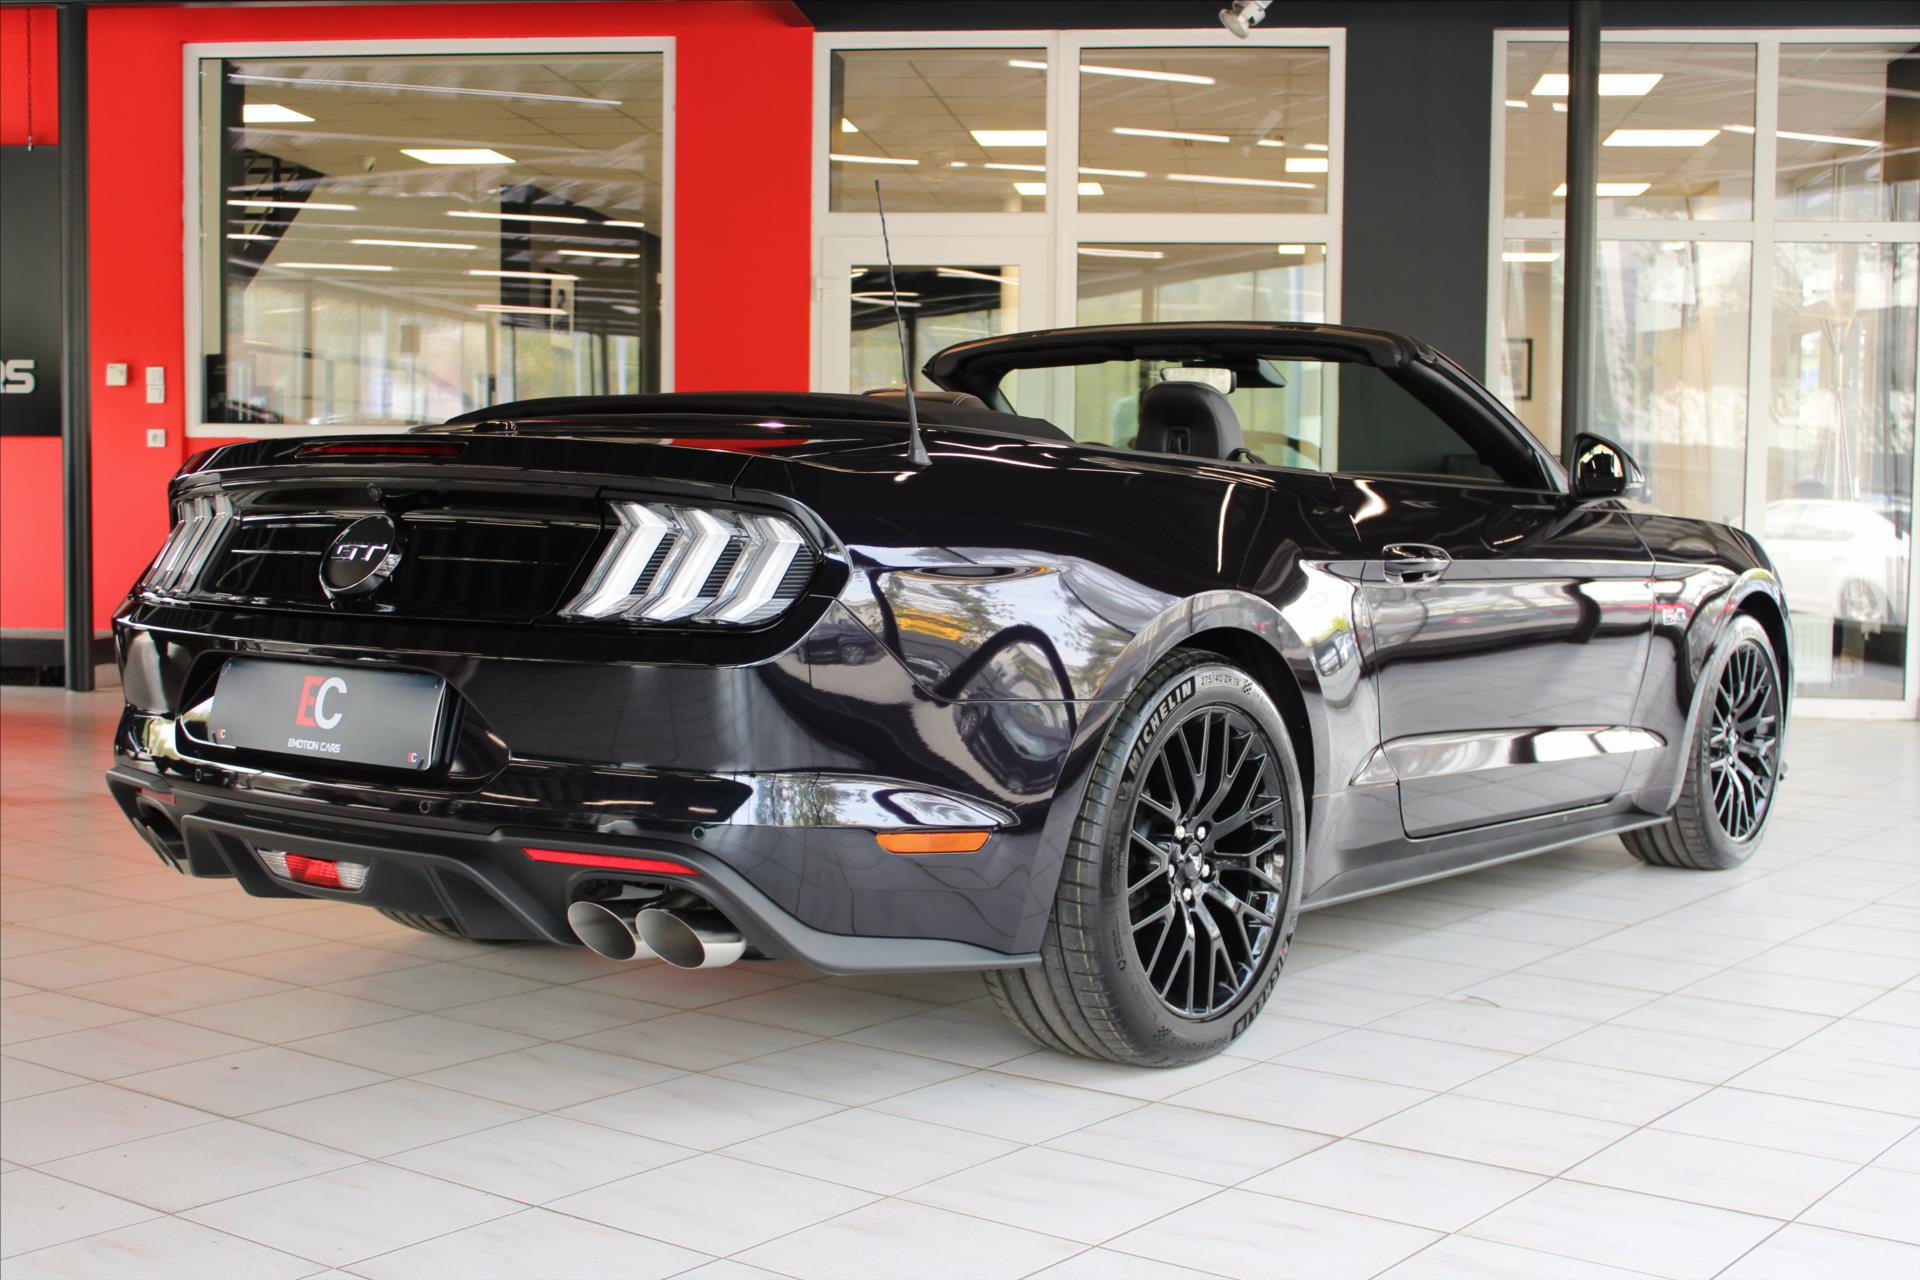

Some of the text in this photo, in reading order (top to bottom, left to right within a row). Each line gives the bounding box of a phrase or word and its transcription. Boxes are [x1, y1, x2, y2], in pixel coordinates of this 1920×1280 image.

[0, 359, 36, 394] S
[331, 543, 388, 562] GT
[296, 675, 347, 729] EC
[1128, 680, 1192, 776] MICHELIN
[287, 738, 341, 753] EMOTION CARS
[407, 751, 418, 763] EC
